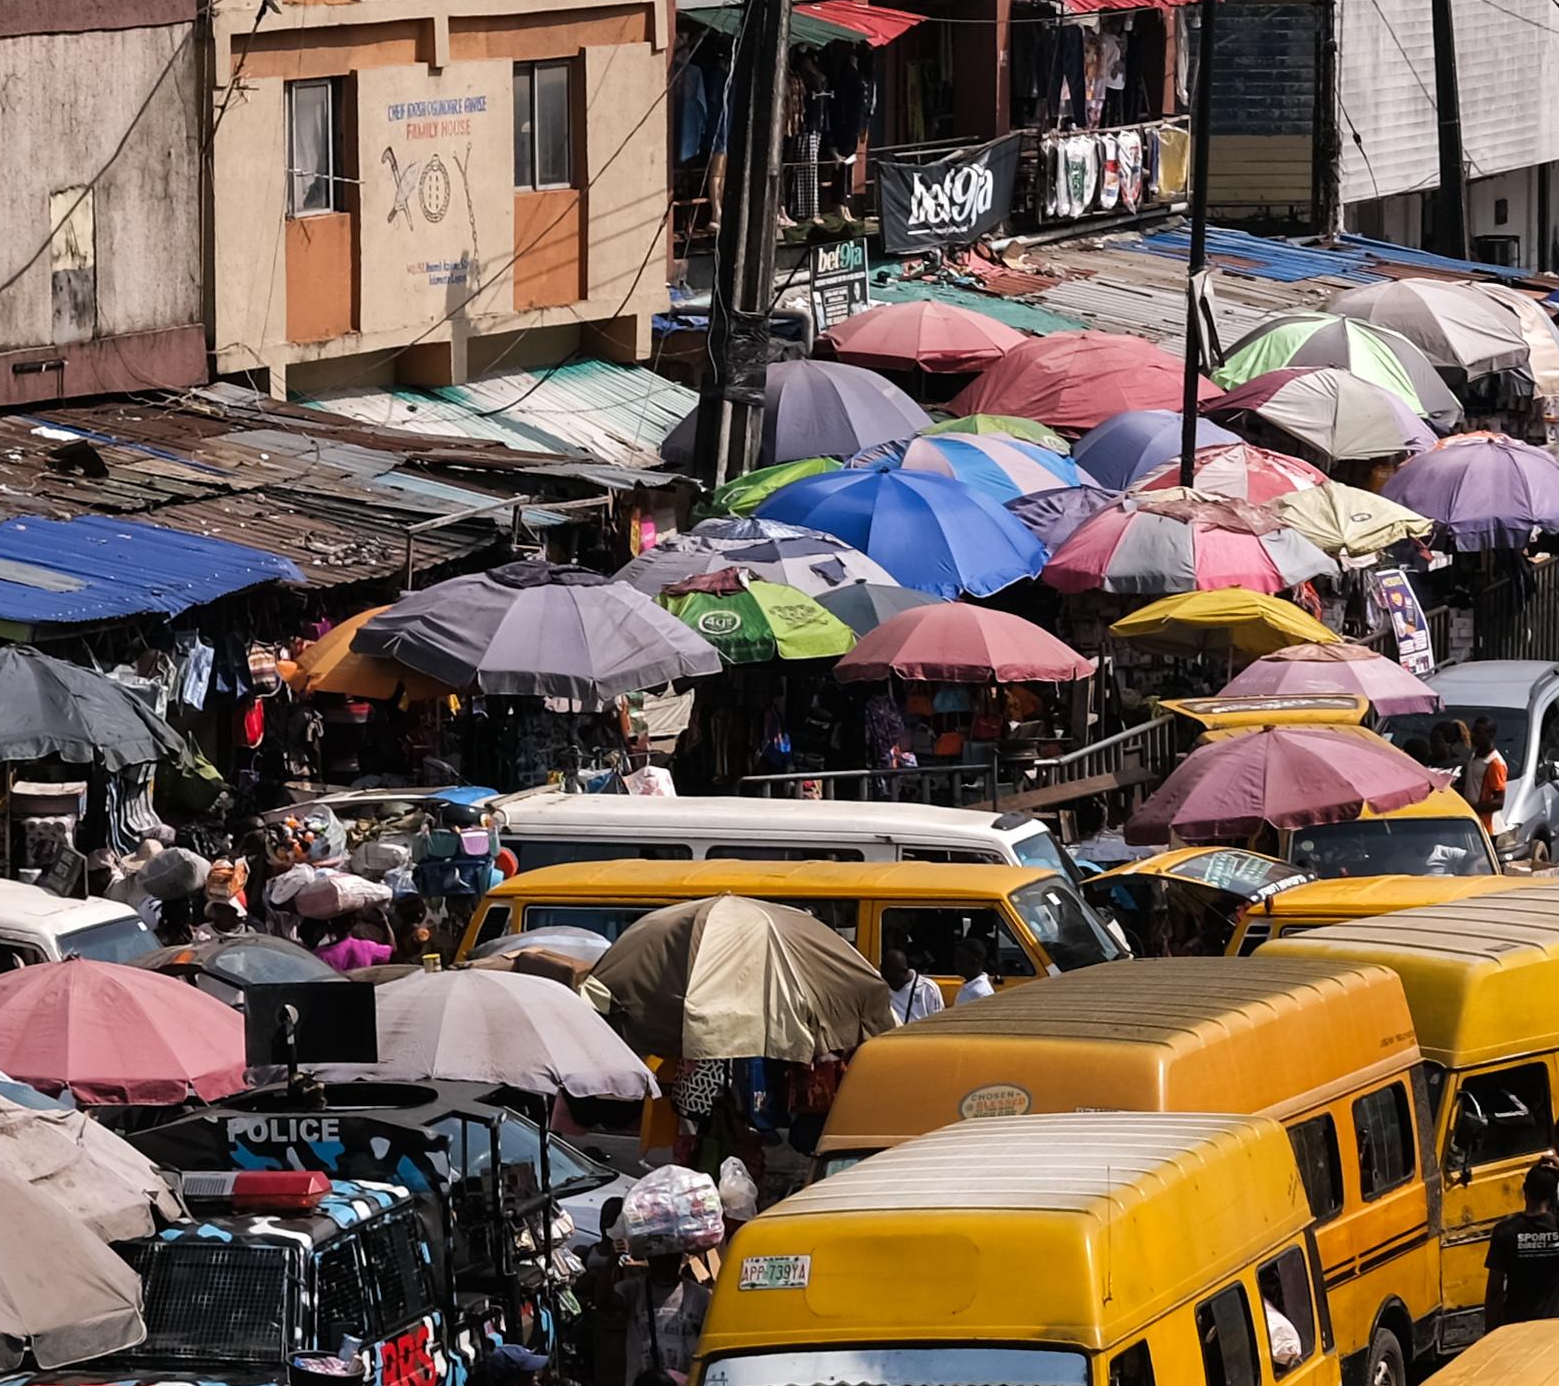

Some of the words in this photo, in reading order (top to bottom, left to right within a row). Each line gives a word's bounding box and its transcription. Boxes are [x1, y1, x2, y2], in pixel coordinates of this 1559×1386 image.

[407, 123, 438, 140] FAMILY
[441, 119, 470, 137] HOUSE
[908, 163, 994, 227] bet9ja
[817, 240, 863, 272] bet9ja
[977, 1097, 1025, 1110] BLESSED
[227, 1118, 340, 1143] POLICE
[1517, 1232, 1559, 1242] SPORTS
